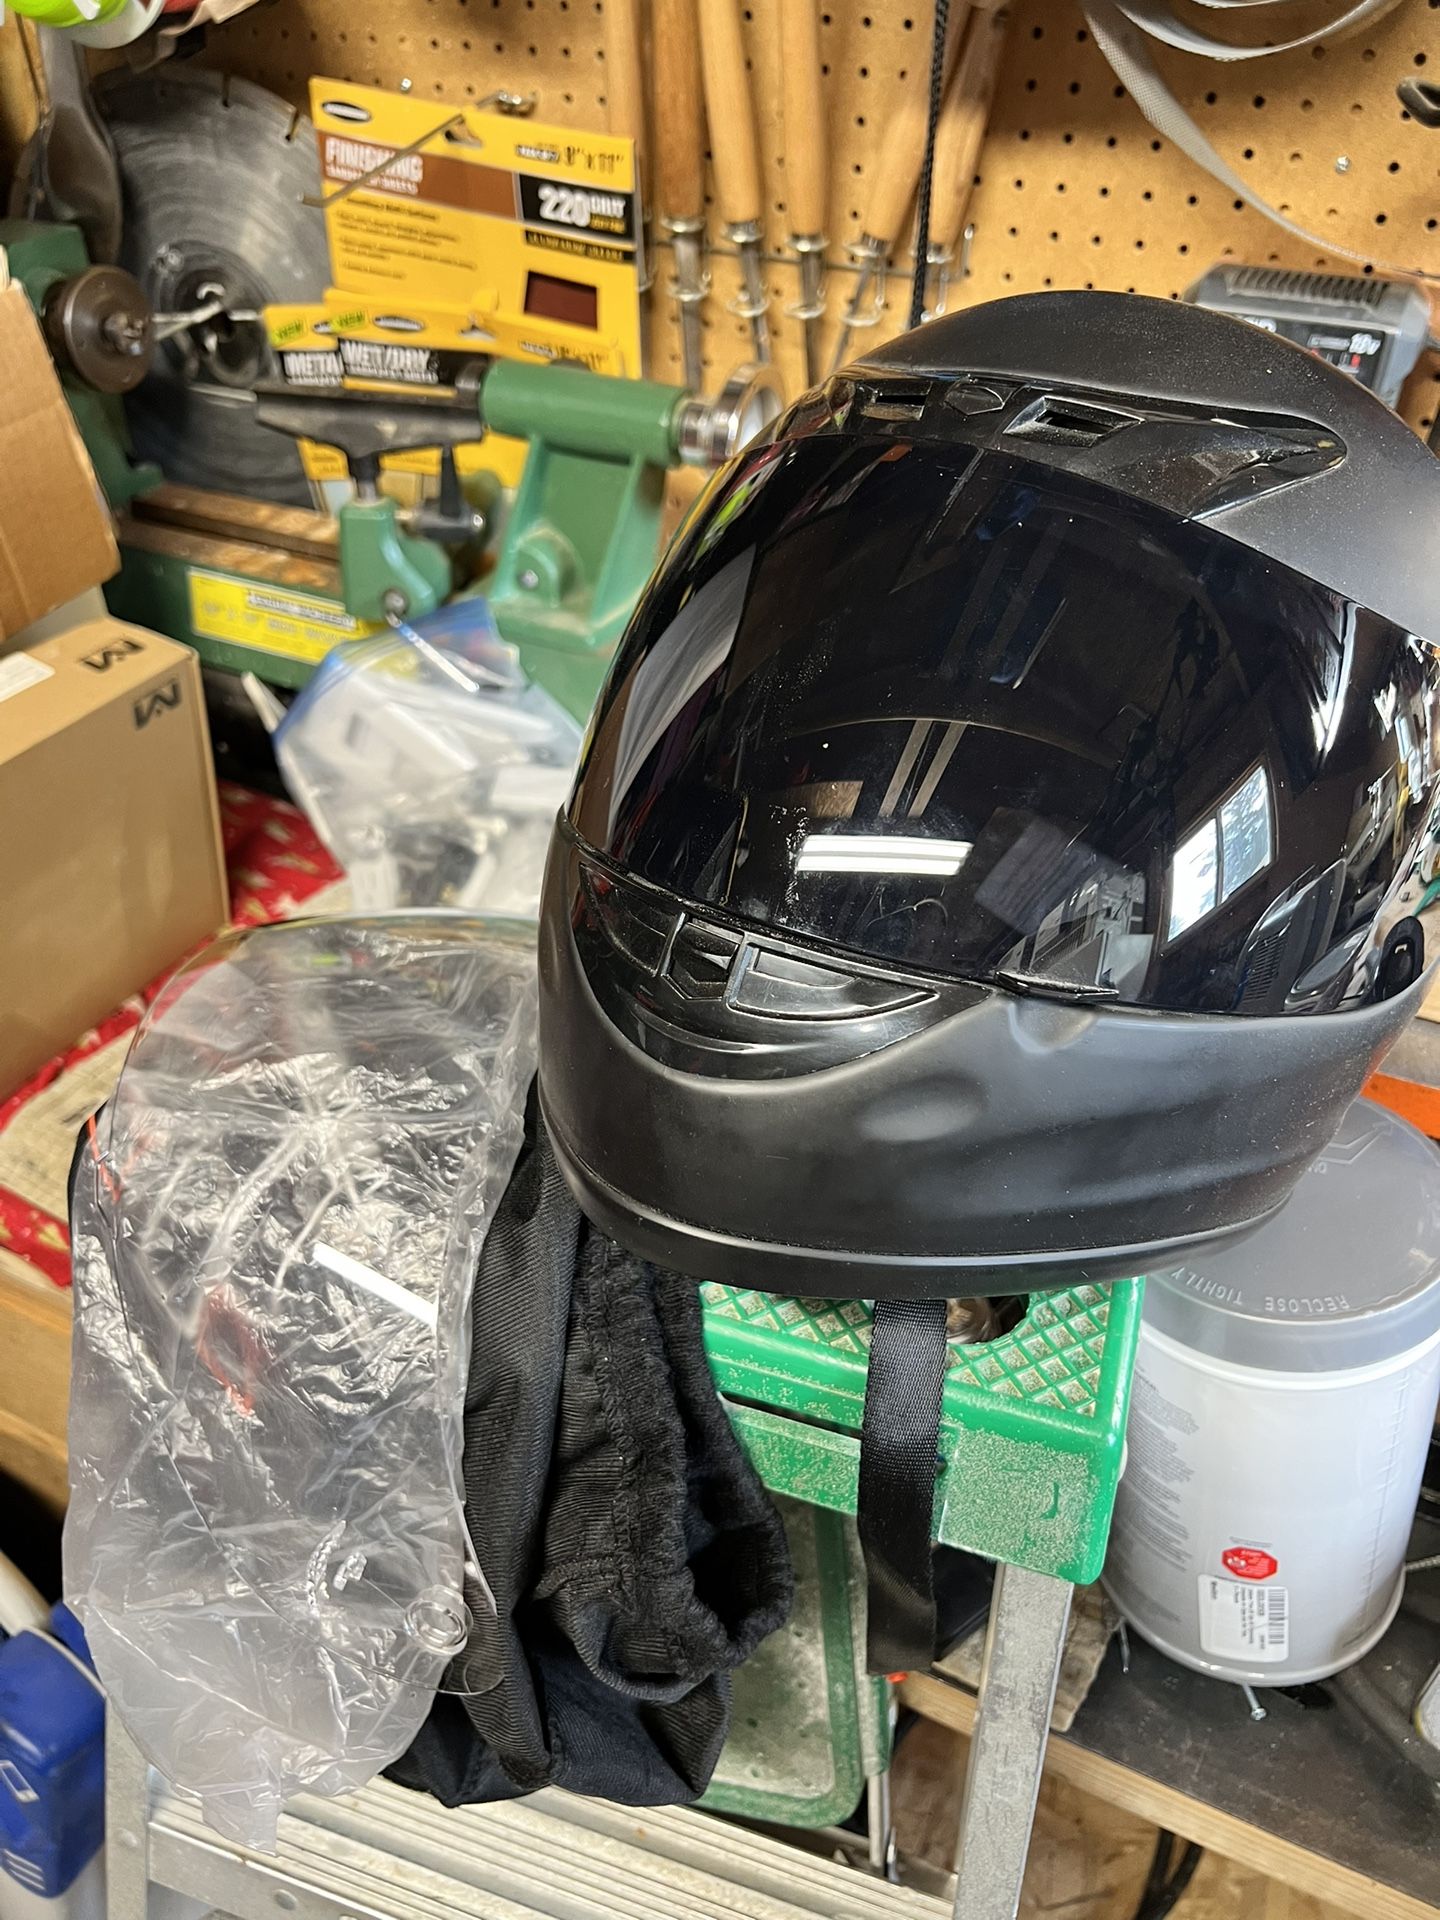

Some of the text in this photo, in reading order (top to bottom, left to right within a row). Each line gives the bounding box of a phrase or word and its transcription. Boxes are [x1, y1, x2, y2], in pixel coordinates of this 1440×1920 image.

[538, 183, 591, 227] 220
[1171, 1266, 1350, 1313] RECLOSE TIGHTLY
